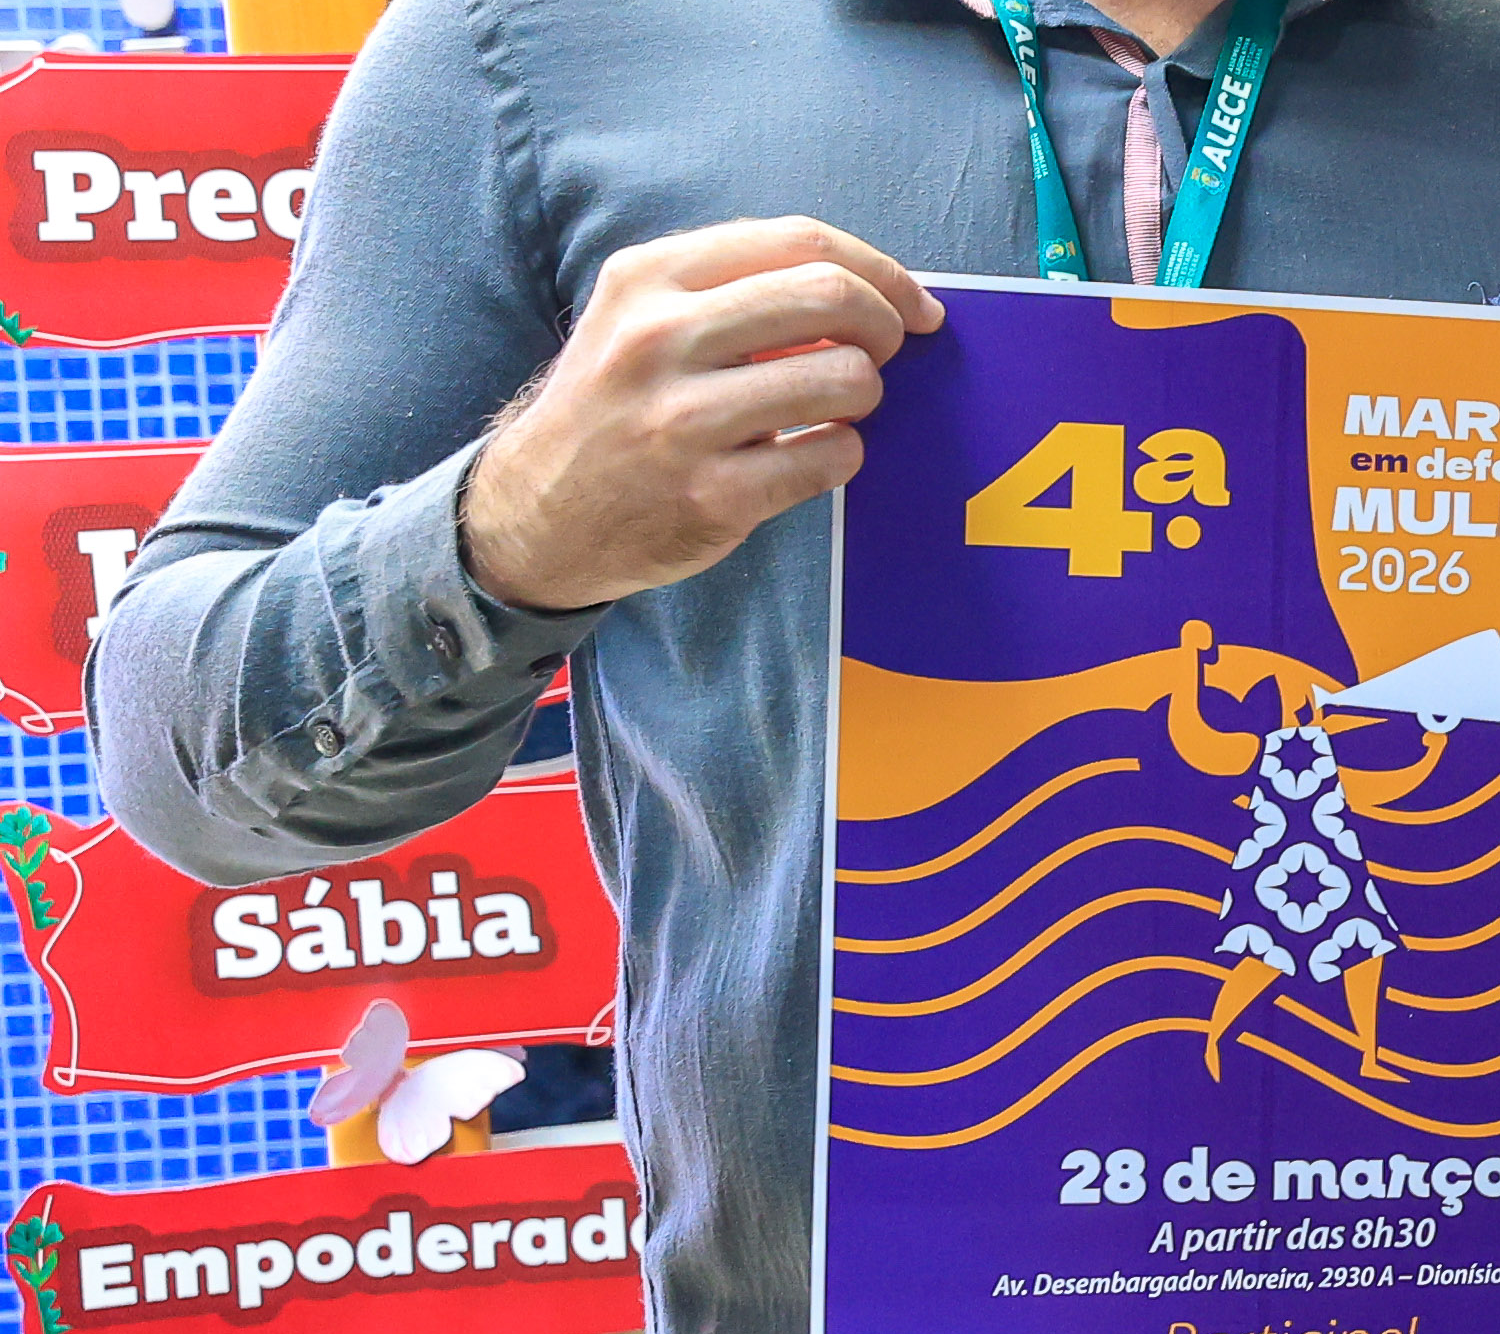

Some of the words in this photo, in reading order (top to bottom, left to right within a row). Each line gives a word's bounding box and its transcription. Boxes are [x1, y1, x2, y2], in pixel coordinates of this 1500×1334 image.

[1200, 73, 1252, 173] ALECE
[1349, 449, 1410, 475] em
[1338, 545, 1471, 597] 2026
[212, 871, 542, 980] Sábia
[1059, 1148, 1148, 1206] 28
[1162, 1146, 1257, 1205] de
[1149, 1221, 1176, 1256] A
[1180, 1219, 1282, 1261] partir
[1286, 1217, 1346, 1251] das
[1351, 1216, 1437, 1251] 8h30
[992, 1273, 1029, 1299] Av.
[1032, 1266, 1219, 1298] Desembargador
[1221, 1266, 1315, 1294] Moreira,
[1317, 1266, 1376, 1290] 2930
[1376, 1265, 1396, 1289] A
